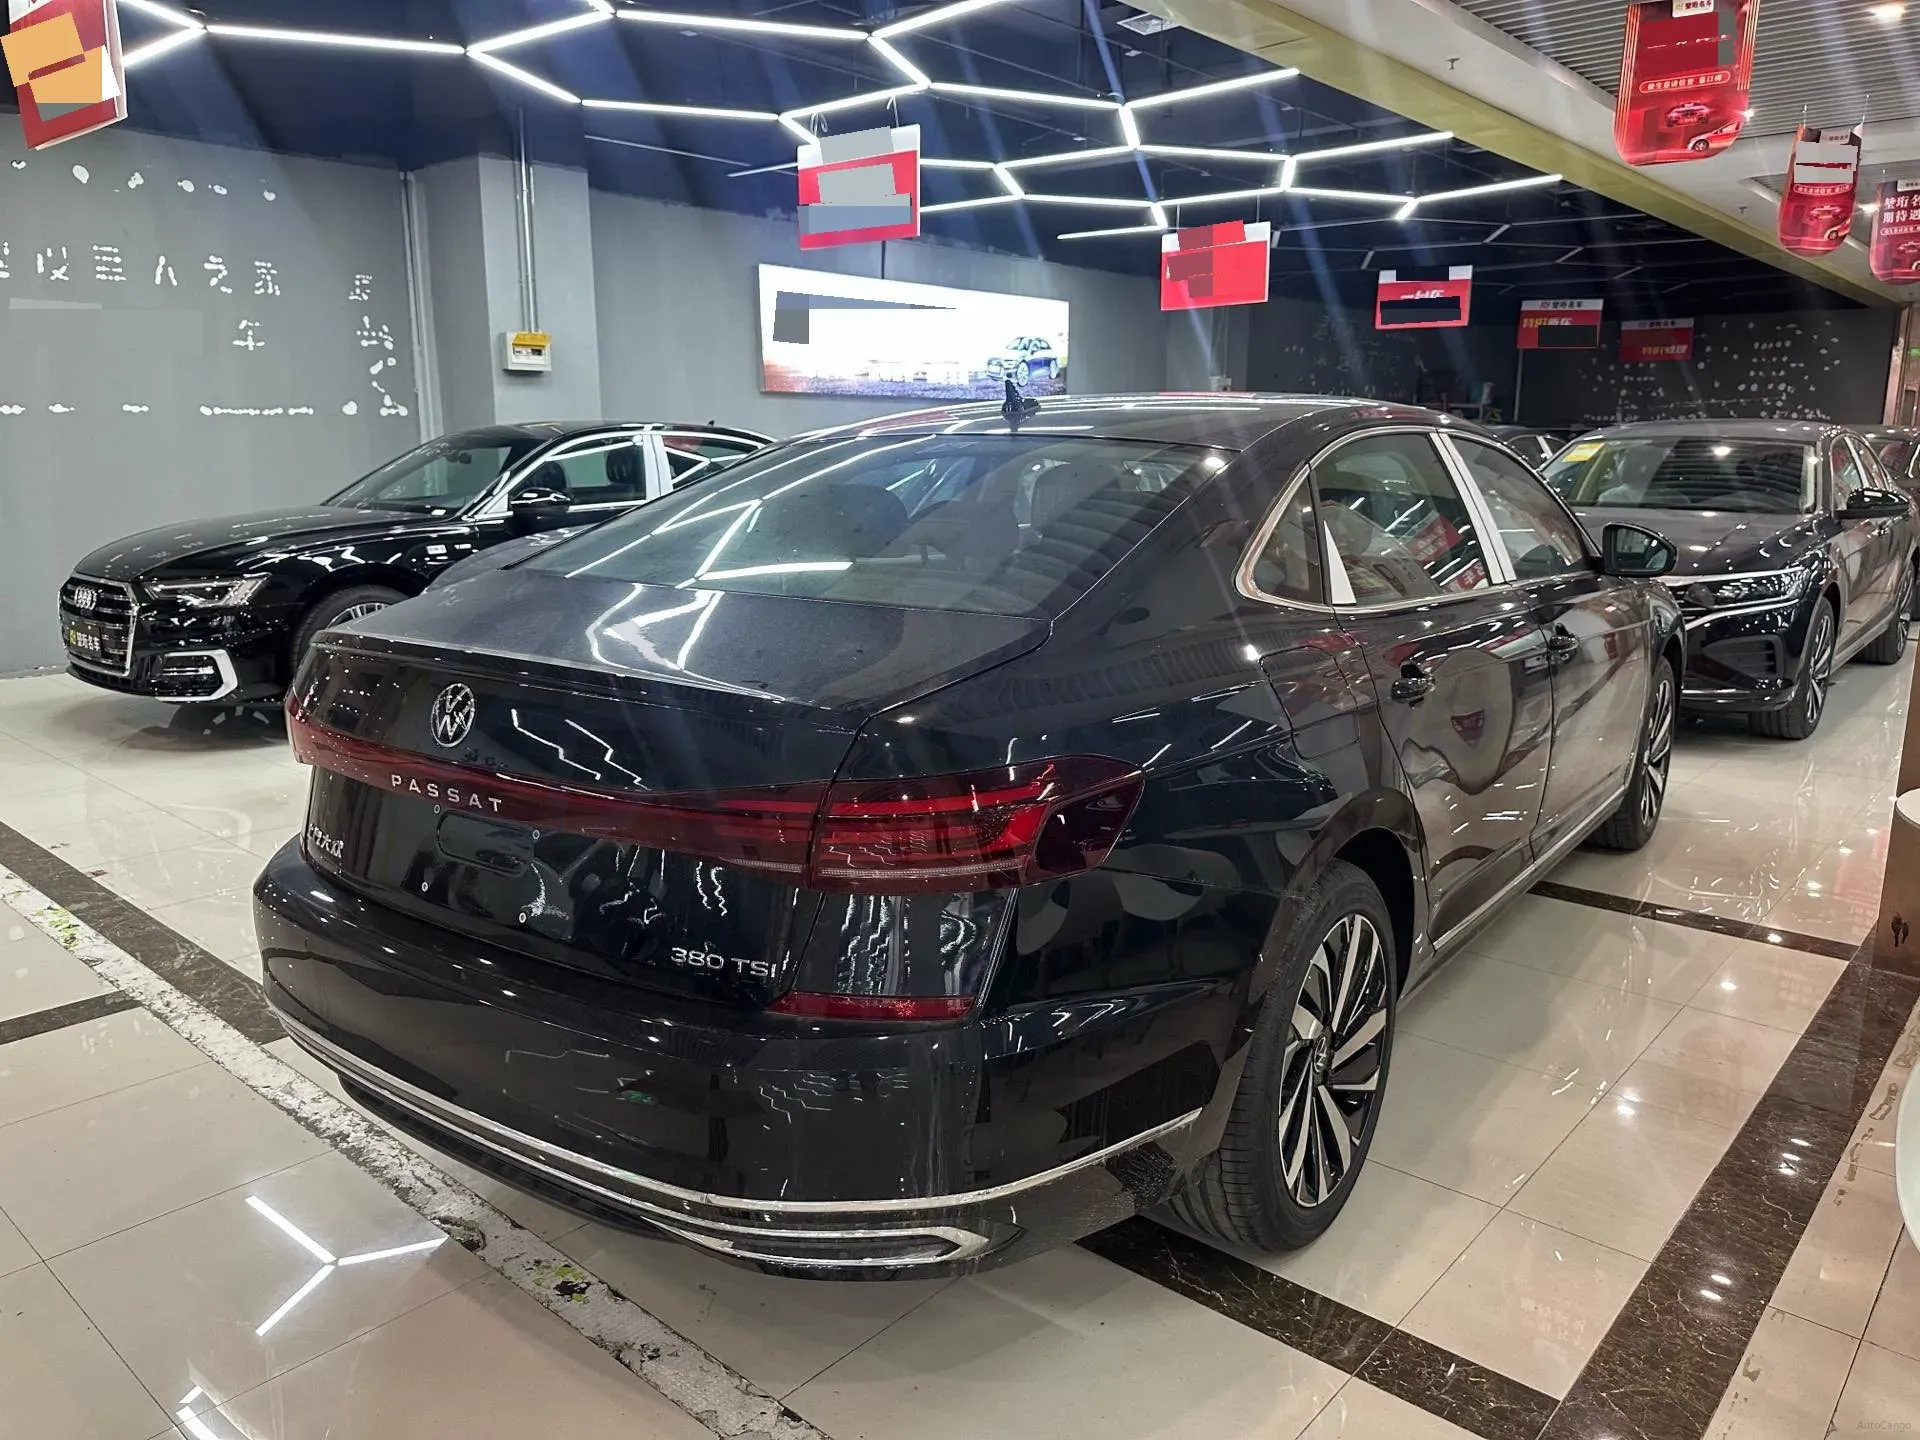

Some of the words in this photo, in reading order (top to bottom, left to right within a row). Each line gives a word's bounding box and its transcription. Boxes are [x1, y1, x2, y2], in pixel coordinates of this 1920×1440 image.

[391, 773, 502, 812] PASSAT
[670, 946, 725, 970] 380
[730, 957, 777, 978] TSI
